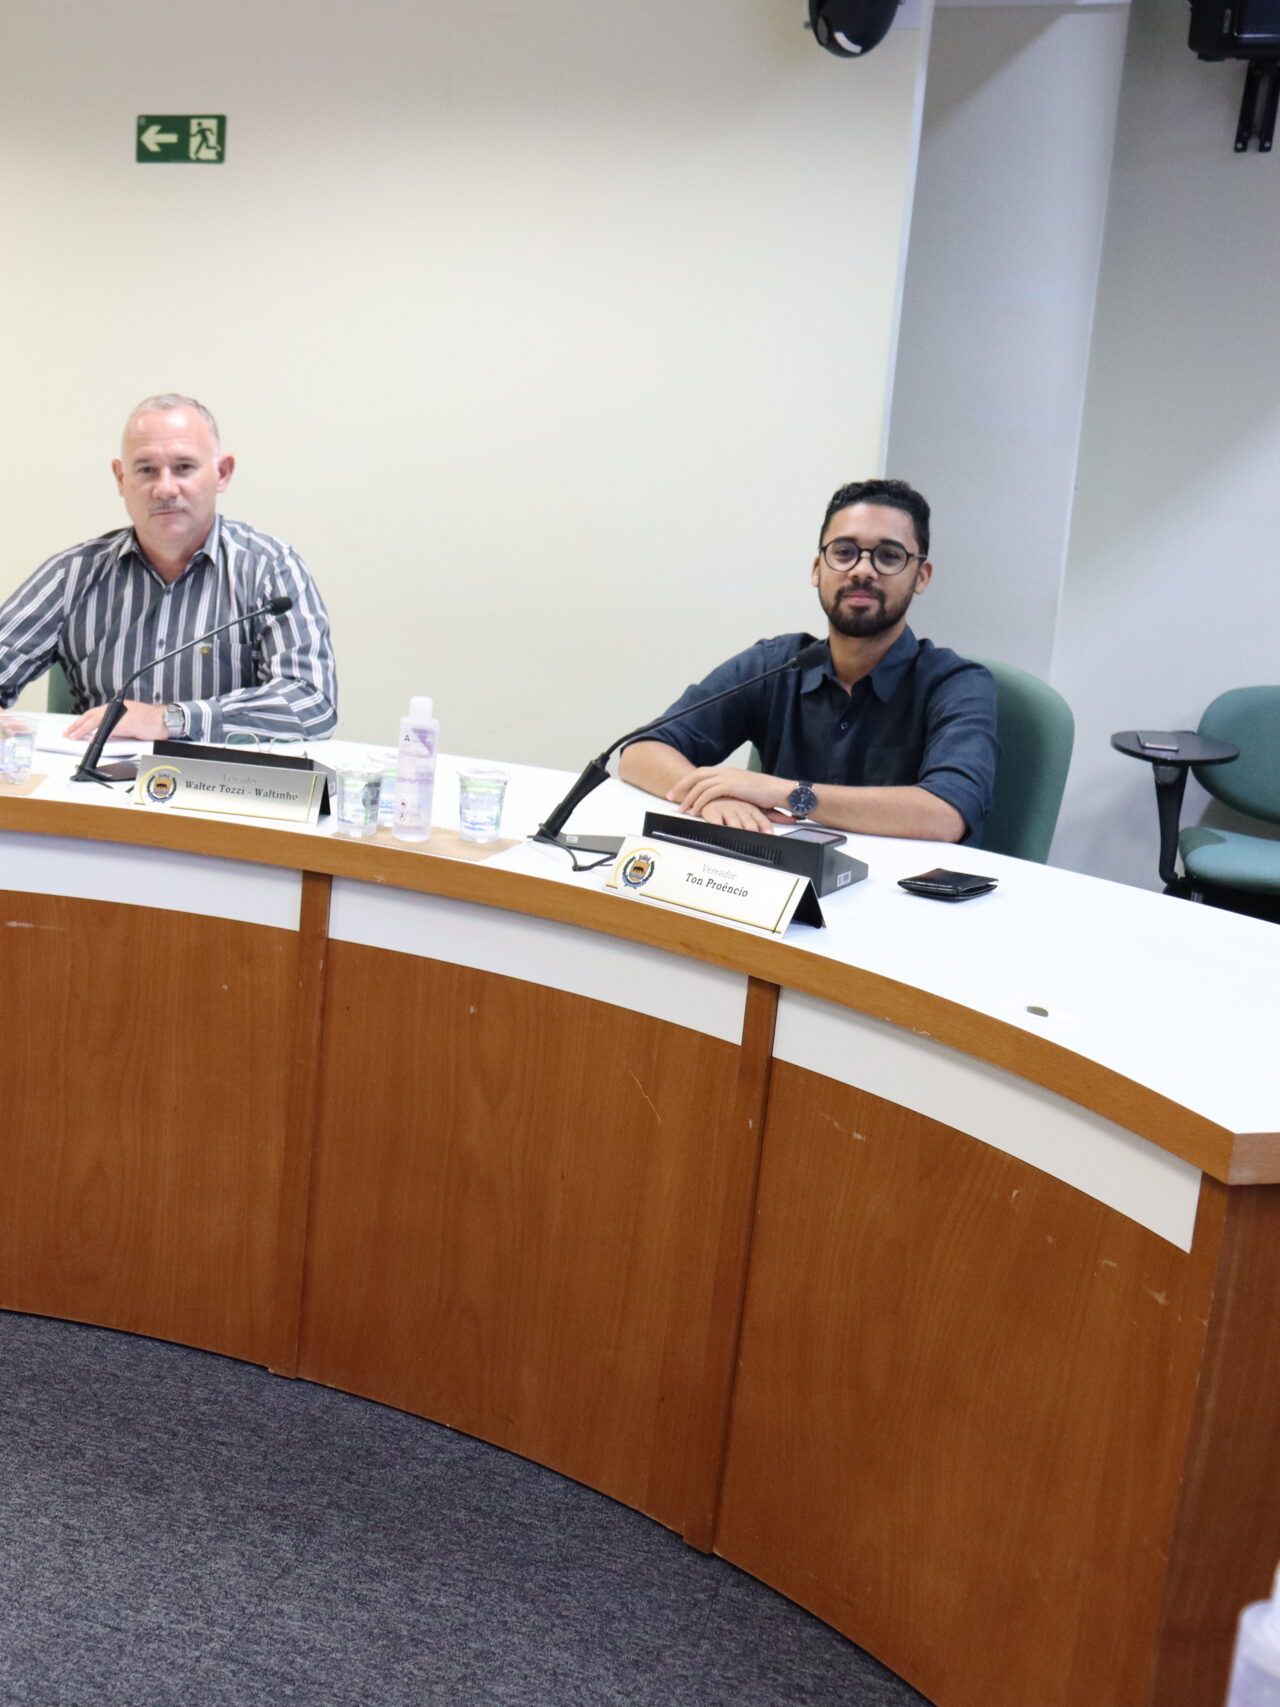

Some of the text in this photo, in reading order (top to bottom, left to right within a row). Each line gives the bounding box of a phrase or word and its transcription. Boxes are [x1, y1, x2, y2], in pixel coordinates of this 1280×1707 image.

[185, 780, 216, 792] Walter
[220, 784, 245, 795] Tozzi
[255, 788, 298, 801] Waltinho
[685, 872, 704, 885] Ton
[702, 863, 737, 880] Vereador
